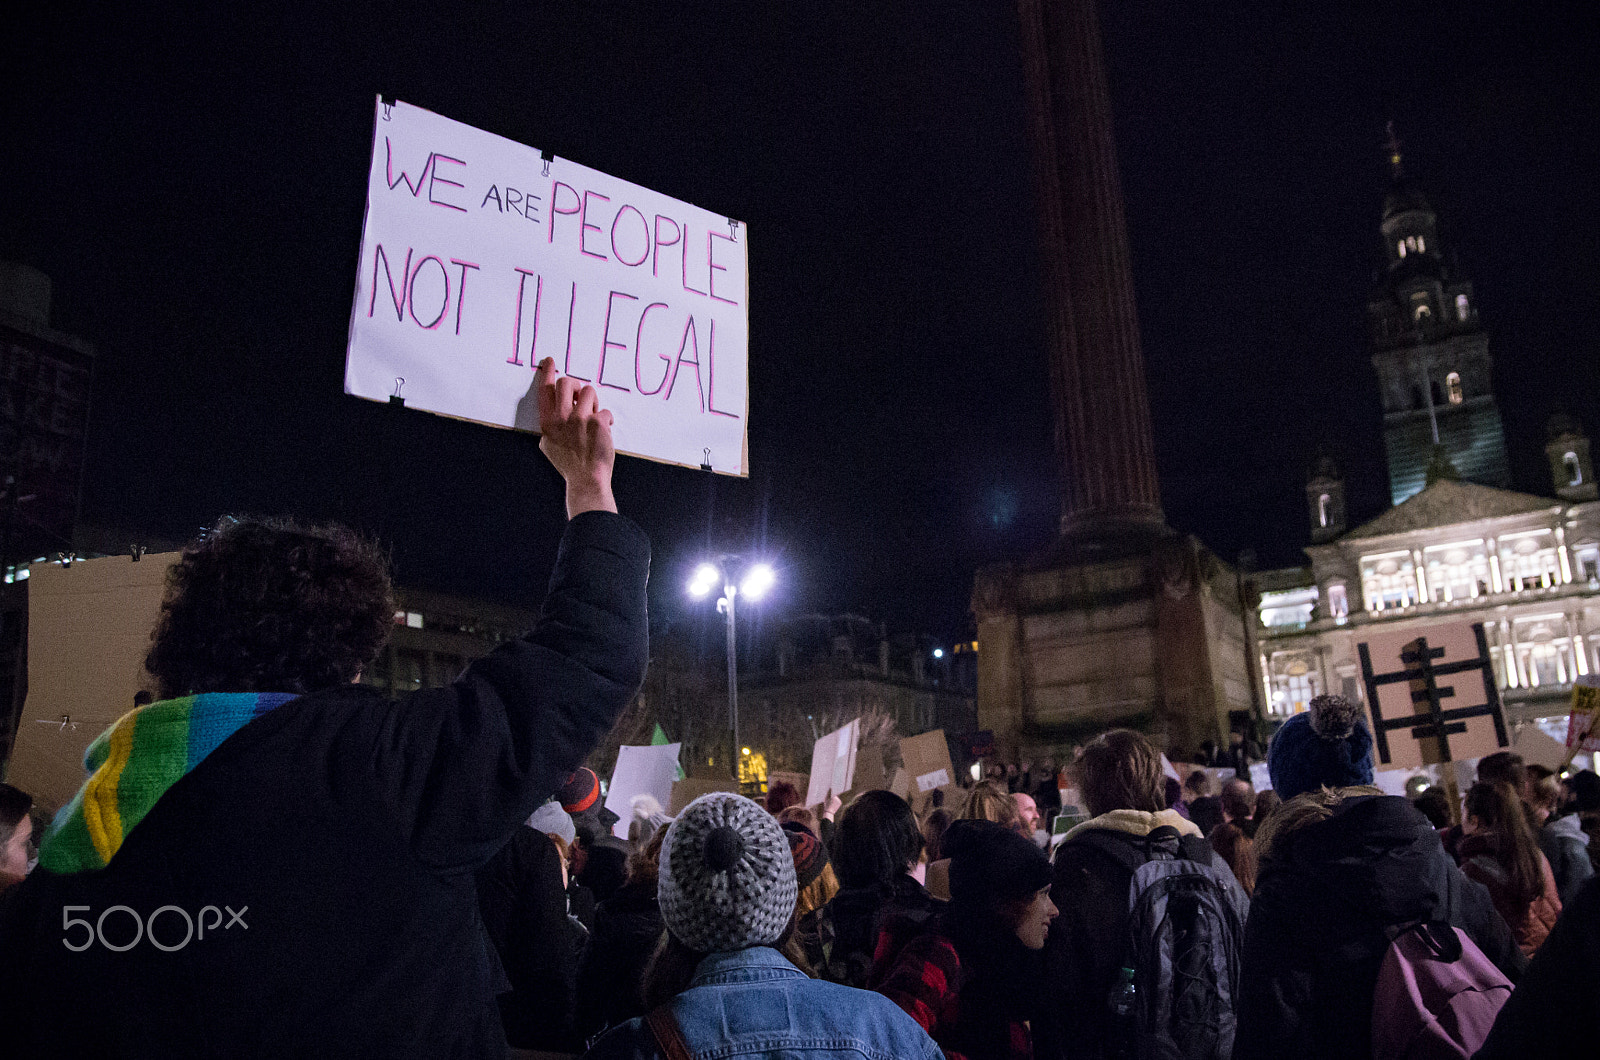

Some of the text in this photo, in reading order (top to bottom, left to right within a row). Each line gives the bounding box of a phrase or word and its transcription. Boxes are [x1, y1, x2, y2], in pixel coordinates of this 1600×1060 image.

[386, 136, 738, 306] WE ARE PEOPLE
[368, 243, 740, 419] NOT ILLEGAL
